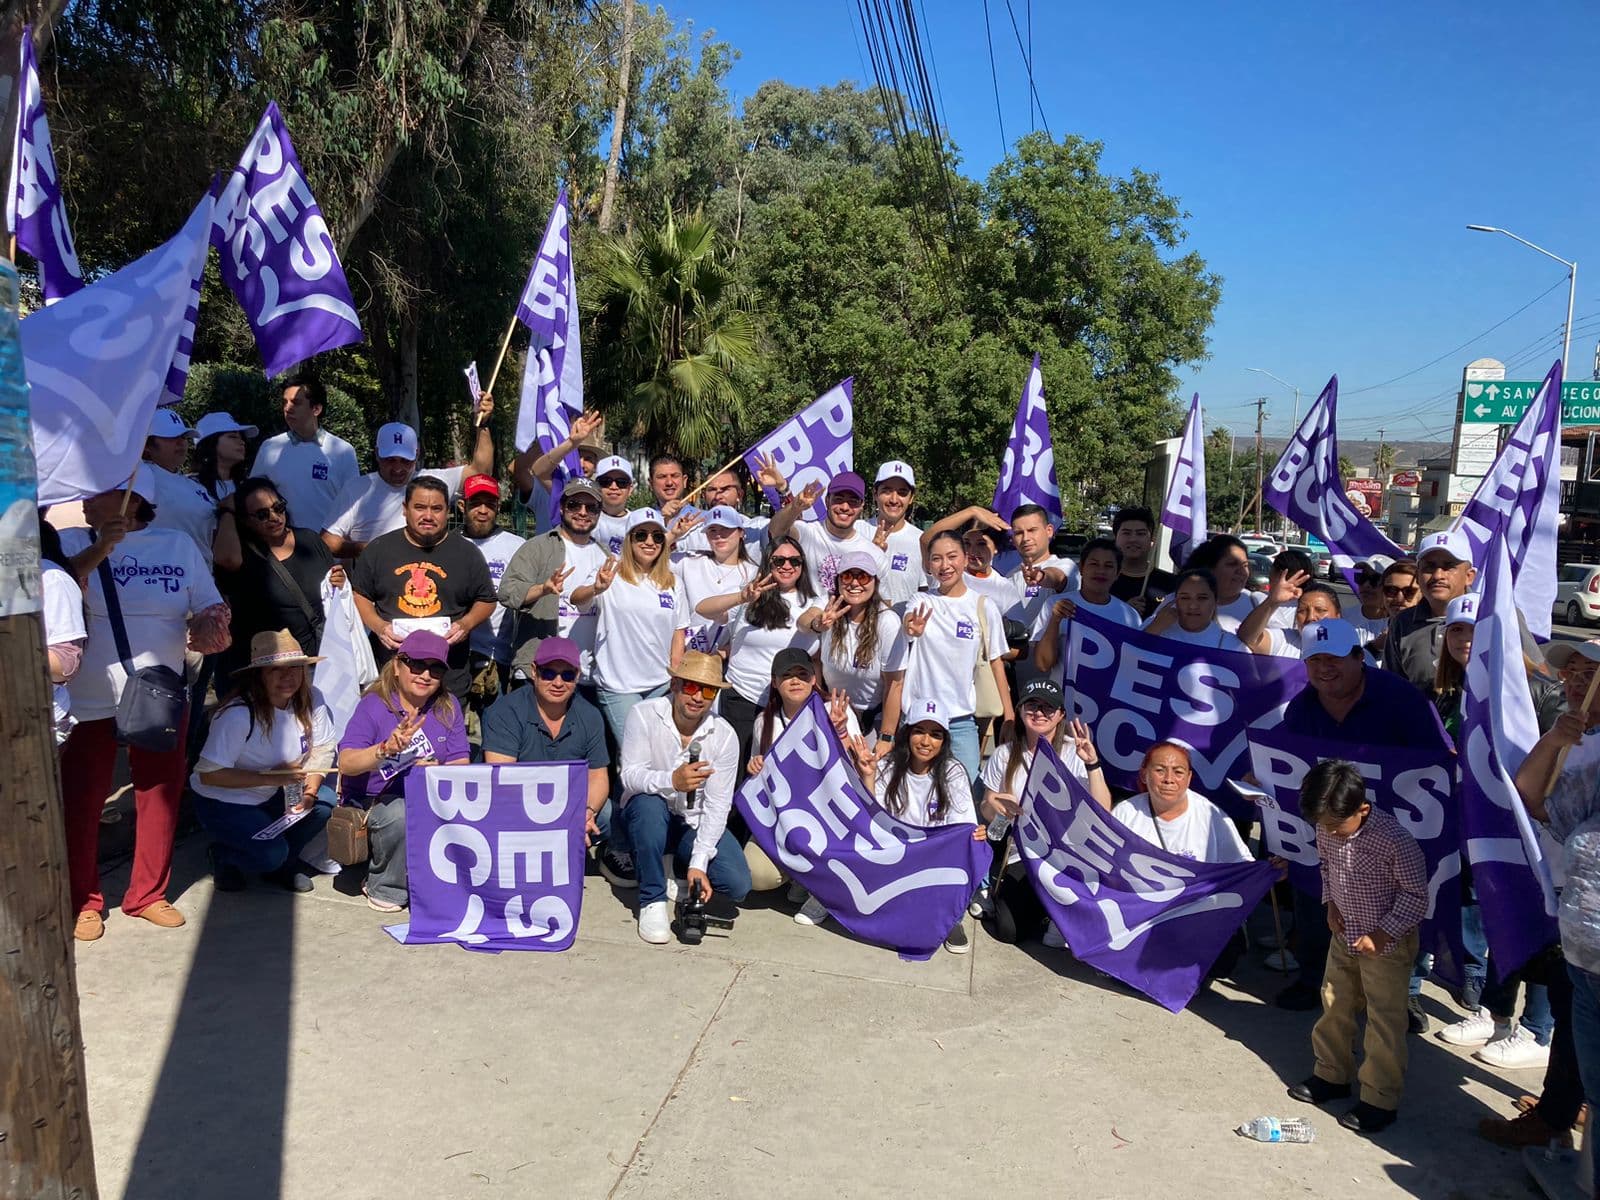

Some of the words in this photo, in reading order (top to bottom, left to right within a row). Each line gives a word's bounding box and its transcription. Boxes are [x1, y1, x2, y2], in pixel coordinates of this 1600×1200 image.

[239, 115, 342, 282] PES
[1503, 387, 1535, 399] SAN
[612, 458, 620, 467] H
[895, 464, 903, 473] H
[646, 510, 654, 519] H
[713, 511, 721, 519] H
[1436, 535, 1448, 545] H
[893, 558, 907, 566] PES
[113, 565, 184, 577] MORADO
[159, 576, 180, 593] TJ
[1461, 600, 1473, 613] H
[958, 626, 973, 635] PES
[1316, 626, 1329, 641] H
[1066, 619, 1241, 727] PES
[926, 701, 936, 713] H
[775, 705, 928, 866] PES
[742, 755, 829, 874] BC
[426, 765, 493, 888] BC
[1028, 748, 1197, 903] PES
[498, 765, 574, 942] PES
